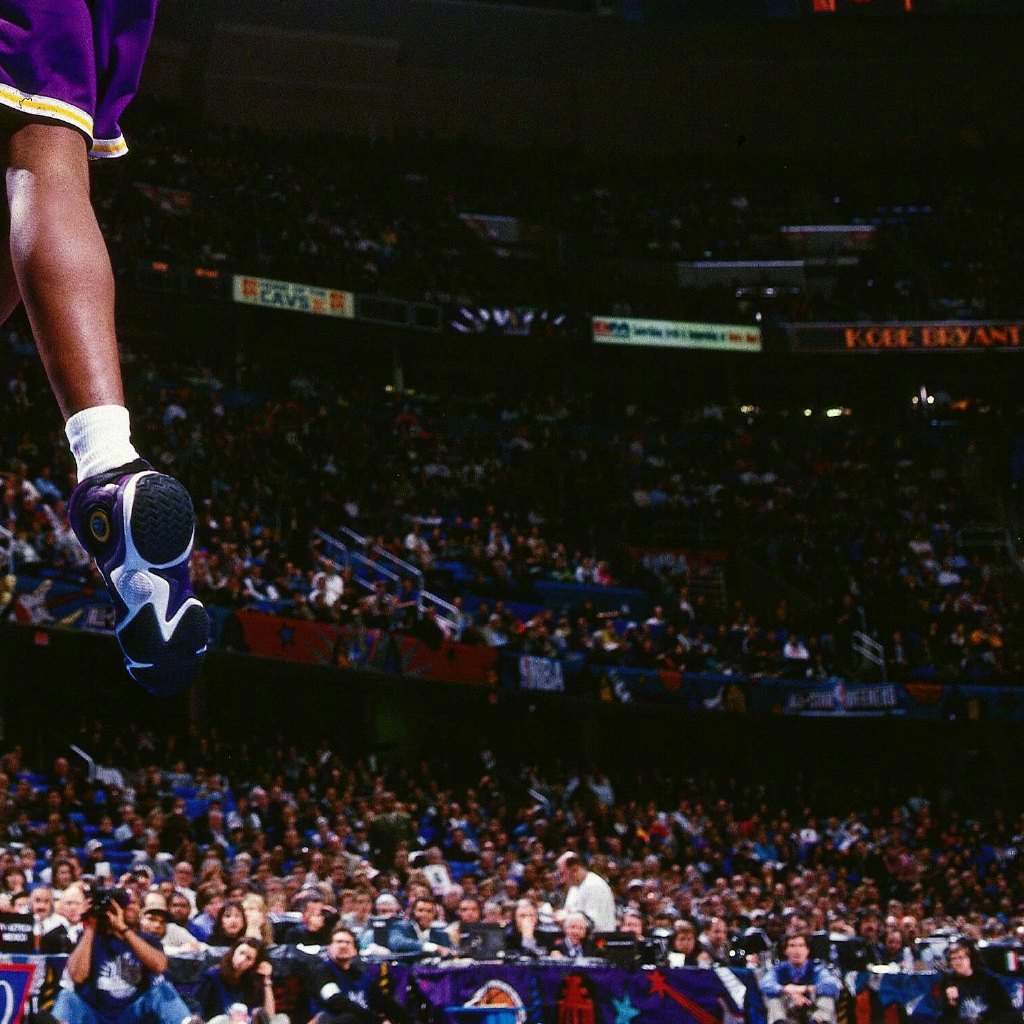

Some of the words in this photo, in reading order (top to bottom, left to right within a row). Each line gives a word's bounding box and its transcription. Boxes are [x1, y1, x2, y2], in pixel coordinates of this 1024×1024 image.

[261, 290, 309, 311] CAVS
[844, 326, 917, 349] KOBE
[921, 324, 1022, 348] BRYANT
